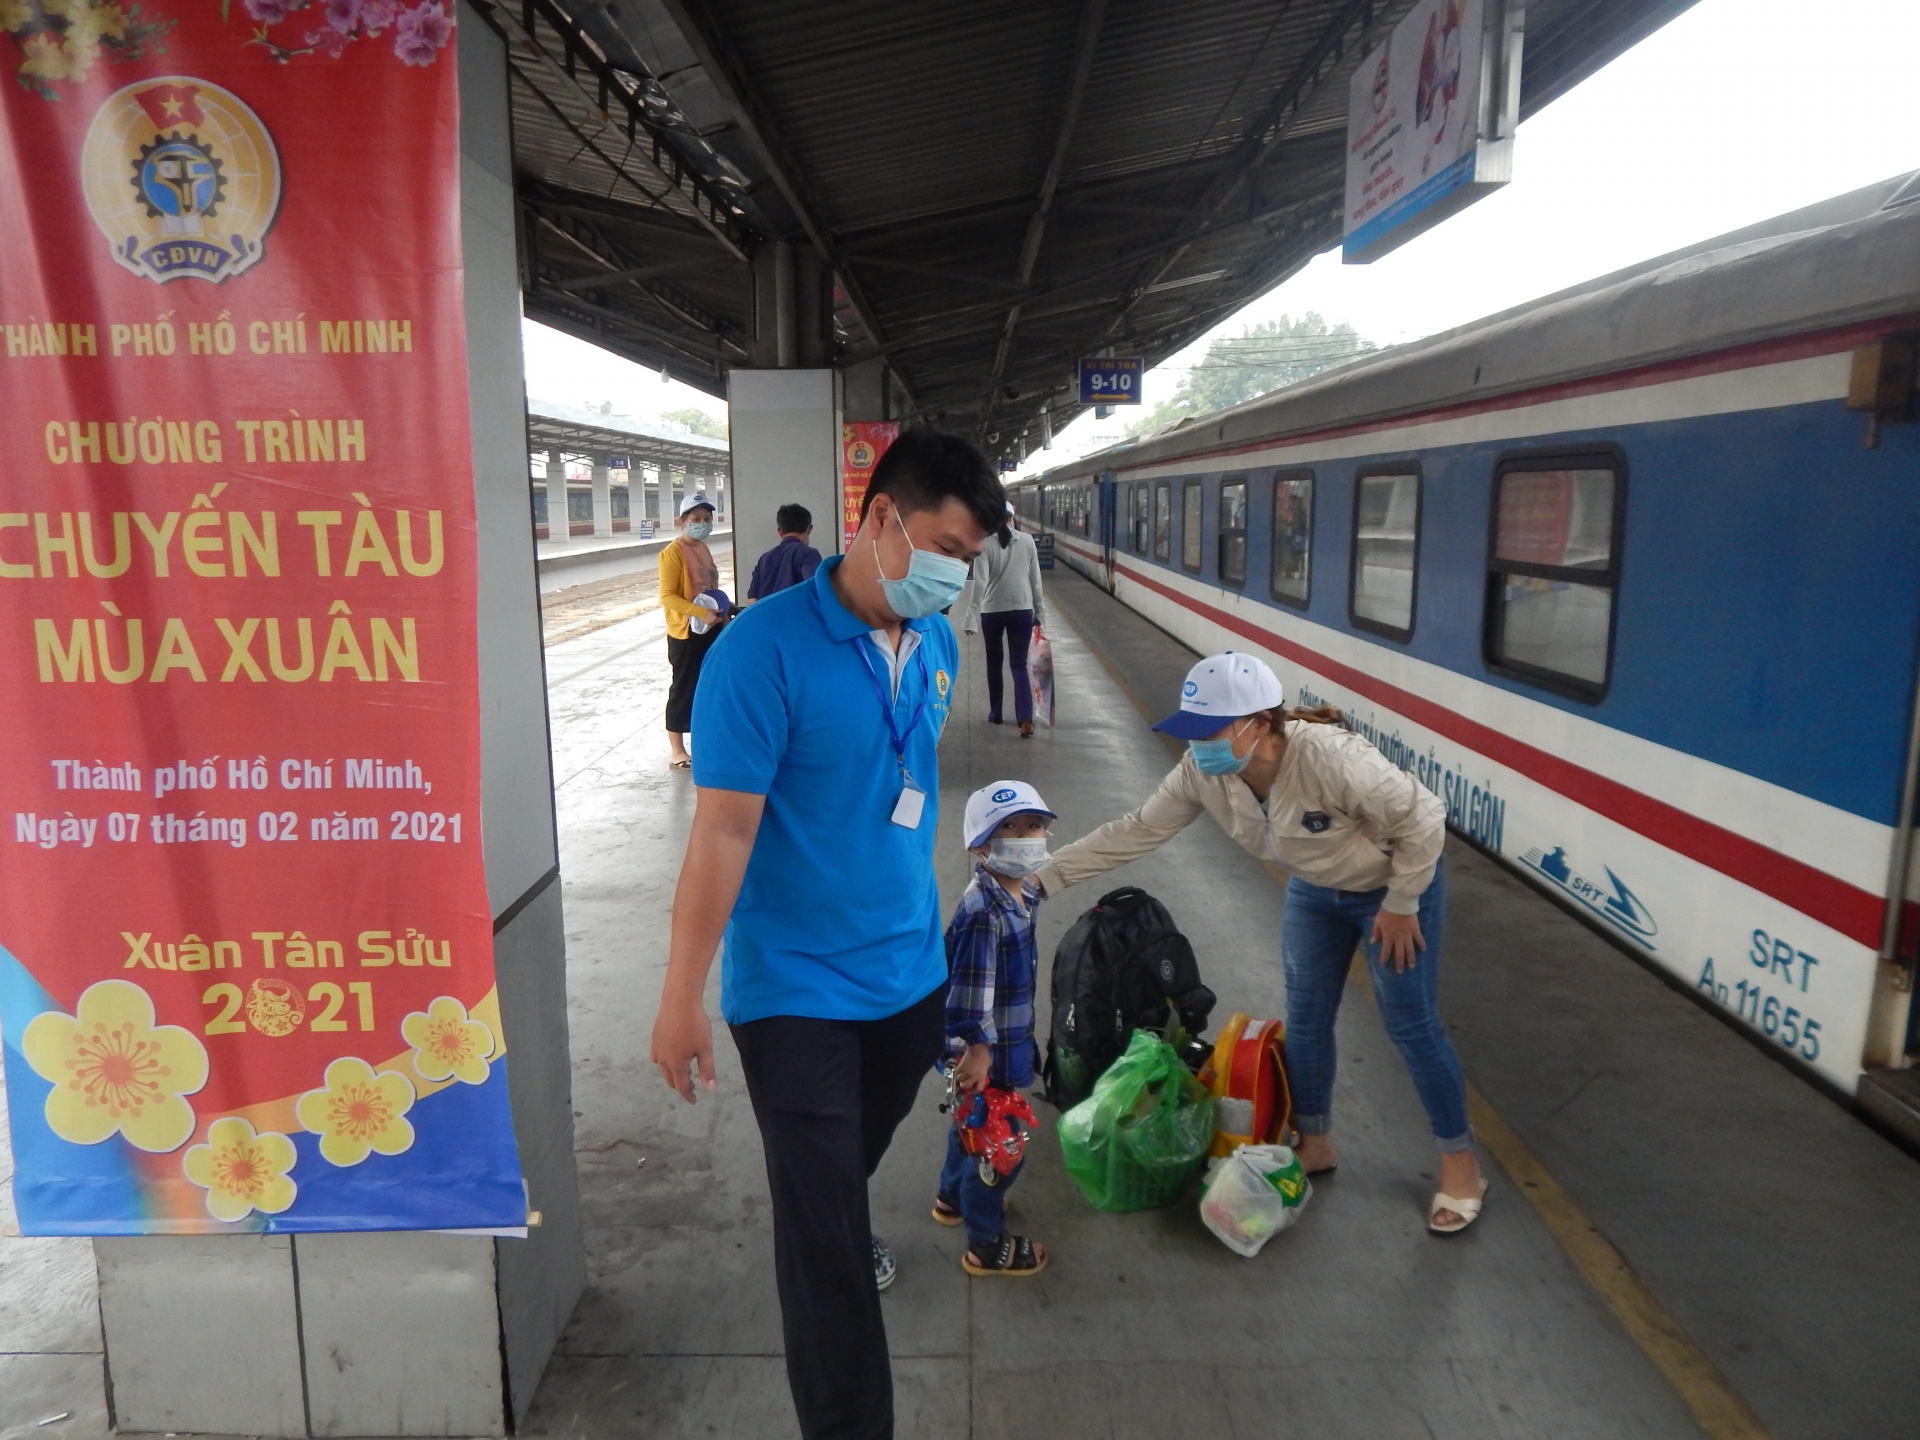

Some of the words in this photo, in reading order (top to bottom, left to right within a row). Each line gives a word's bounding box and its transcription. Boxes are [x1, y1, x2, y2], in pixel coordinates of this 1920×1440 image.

[0, 315, 97, 357] HÀNH
[112, 310, 176, 357] PHỐ
[189, 309, 236, 356] HỒ
[249, 314, 307, 354] CHÍ
[320, 319, 413, 354] MINH
[1091, 374, 1131, 390] 9-10
[45, 416, 223, 465] CHƯƠNG
[237, 409, 366, 463] TRÌNH
[0, 482, 281, 579] CHUYẾN
[297, 493, 445, 578] TÀU
[34, 601, 208, 685] MÙA
[214, 600, 421, 683] XUÂN
[51, 758, 141, 792] Thành
[155, 755, 218, 798] phố
[228, 756, 269, 790] Hồ
[280, 758, 334, 790] Chí
[345, 758, 433, 795] Minh,
[995, 791, 1014, 801] CEP
[15, 811, 97, 849] Ngày
[108, 812, 141, 841] 07
[150, 811, 246, 847] tháng
[259, 812, 298, 841] 02
[311, 810, 379, 841] năm
[390, 811, 462, 843] 2021
[1571, 875, 1604, 903] SRT
[120, 931, 242, 971] Xuân
[252, 931, 345, 968] Tân
[357, 928, 452, 967] Sửu
[1749, 928, 1820, 993] SRT
[1698, 957, 1729, 1007] An
[1735, 978, 1822, 1062] 11655
